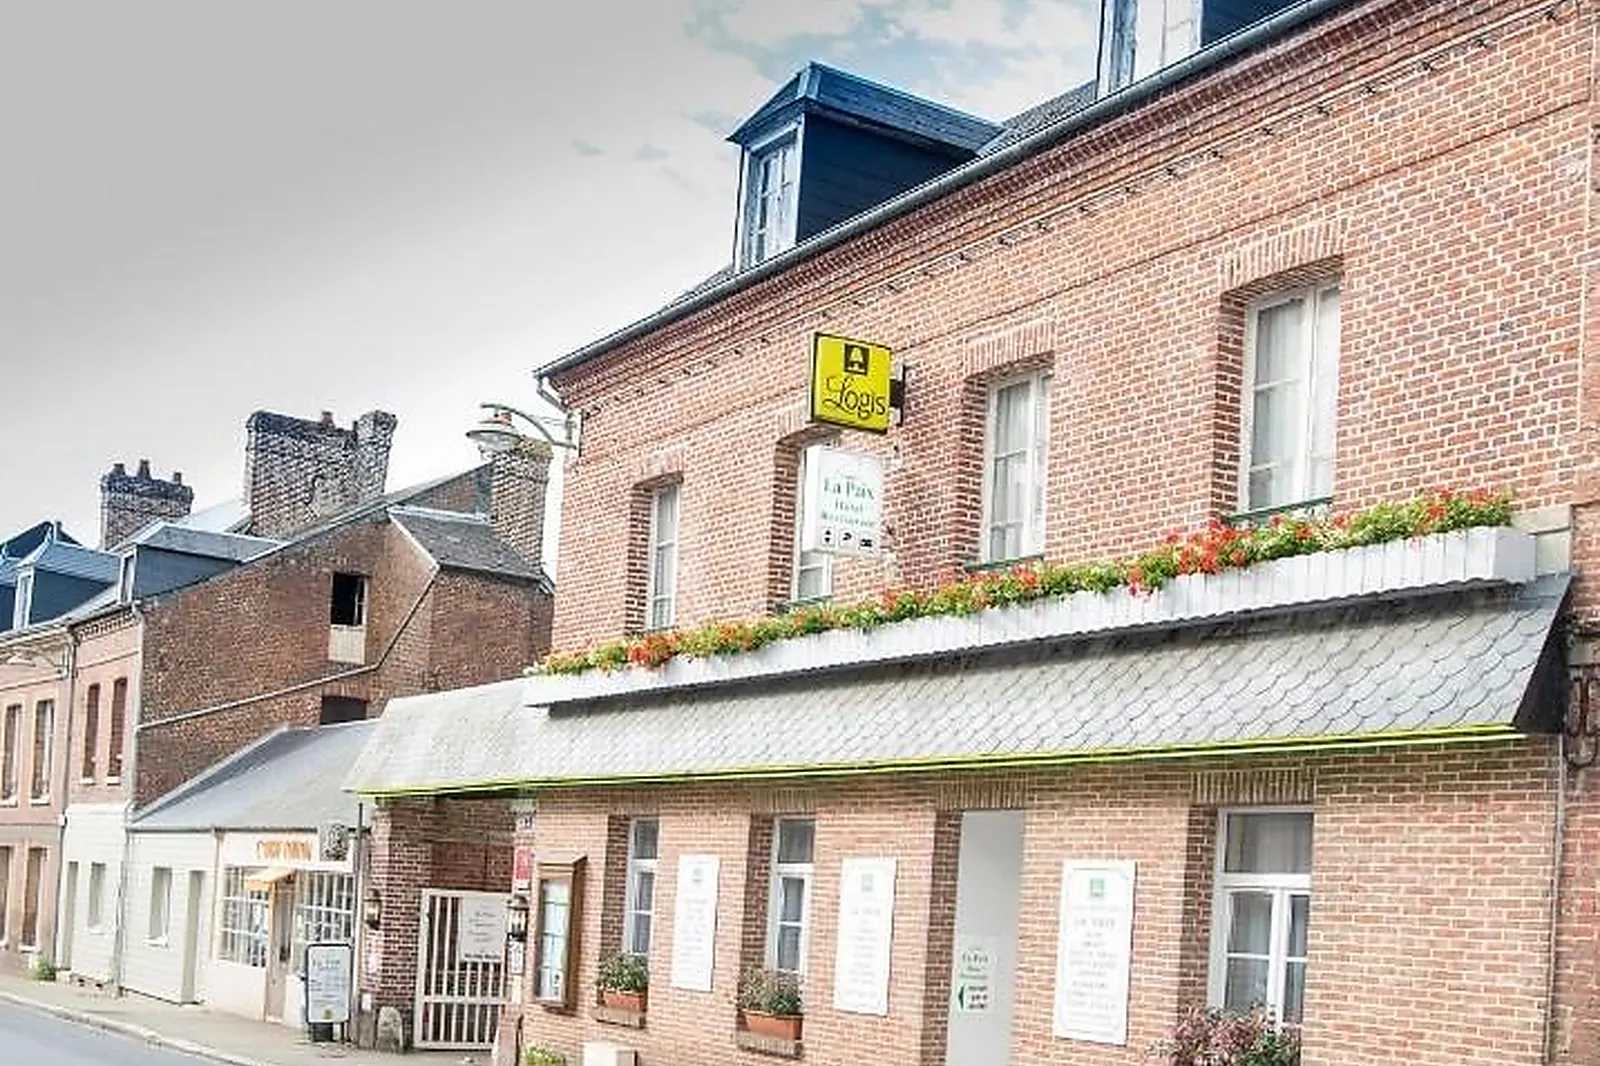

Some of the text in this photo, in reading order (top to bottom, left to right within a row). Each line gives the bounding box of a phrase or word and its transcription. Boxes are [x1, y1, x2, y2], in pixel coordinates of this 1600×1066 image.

[822, 375, 886, 420] Logis
[823, 477, 875, 500] La Paix
